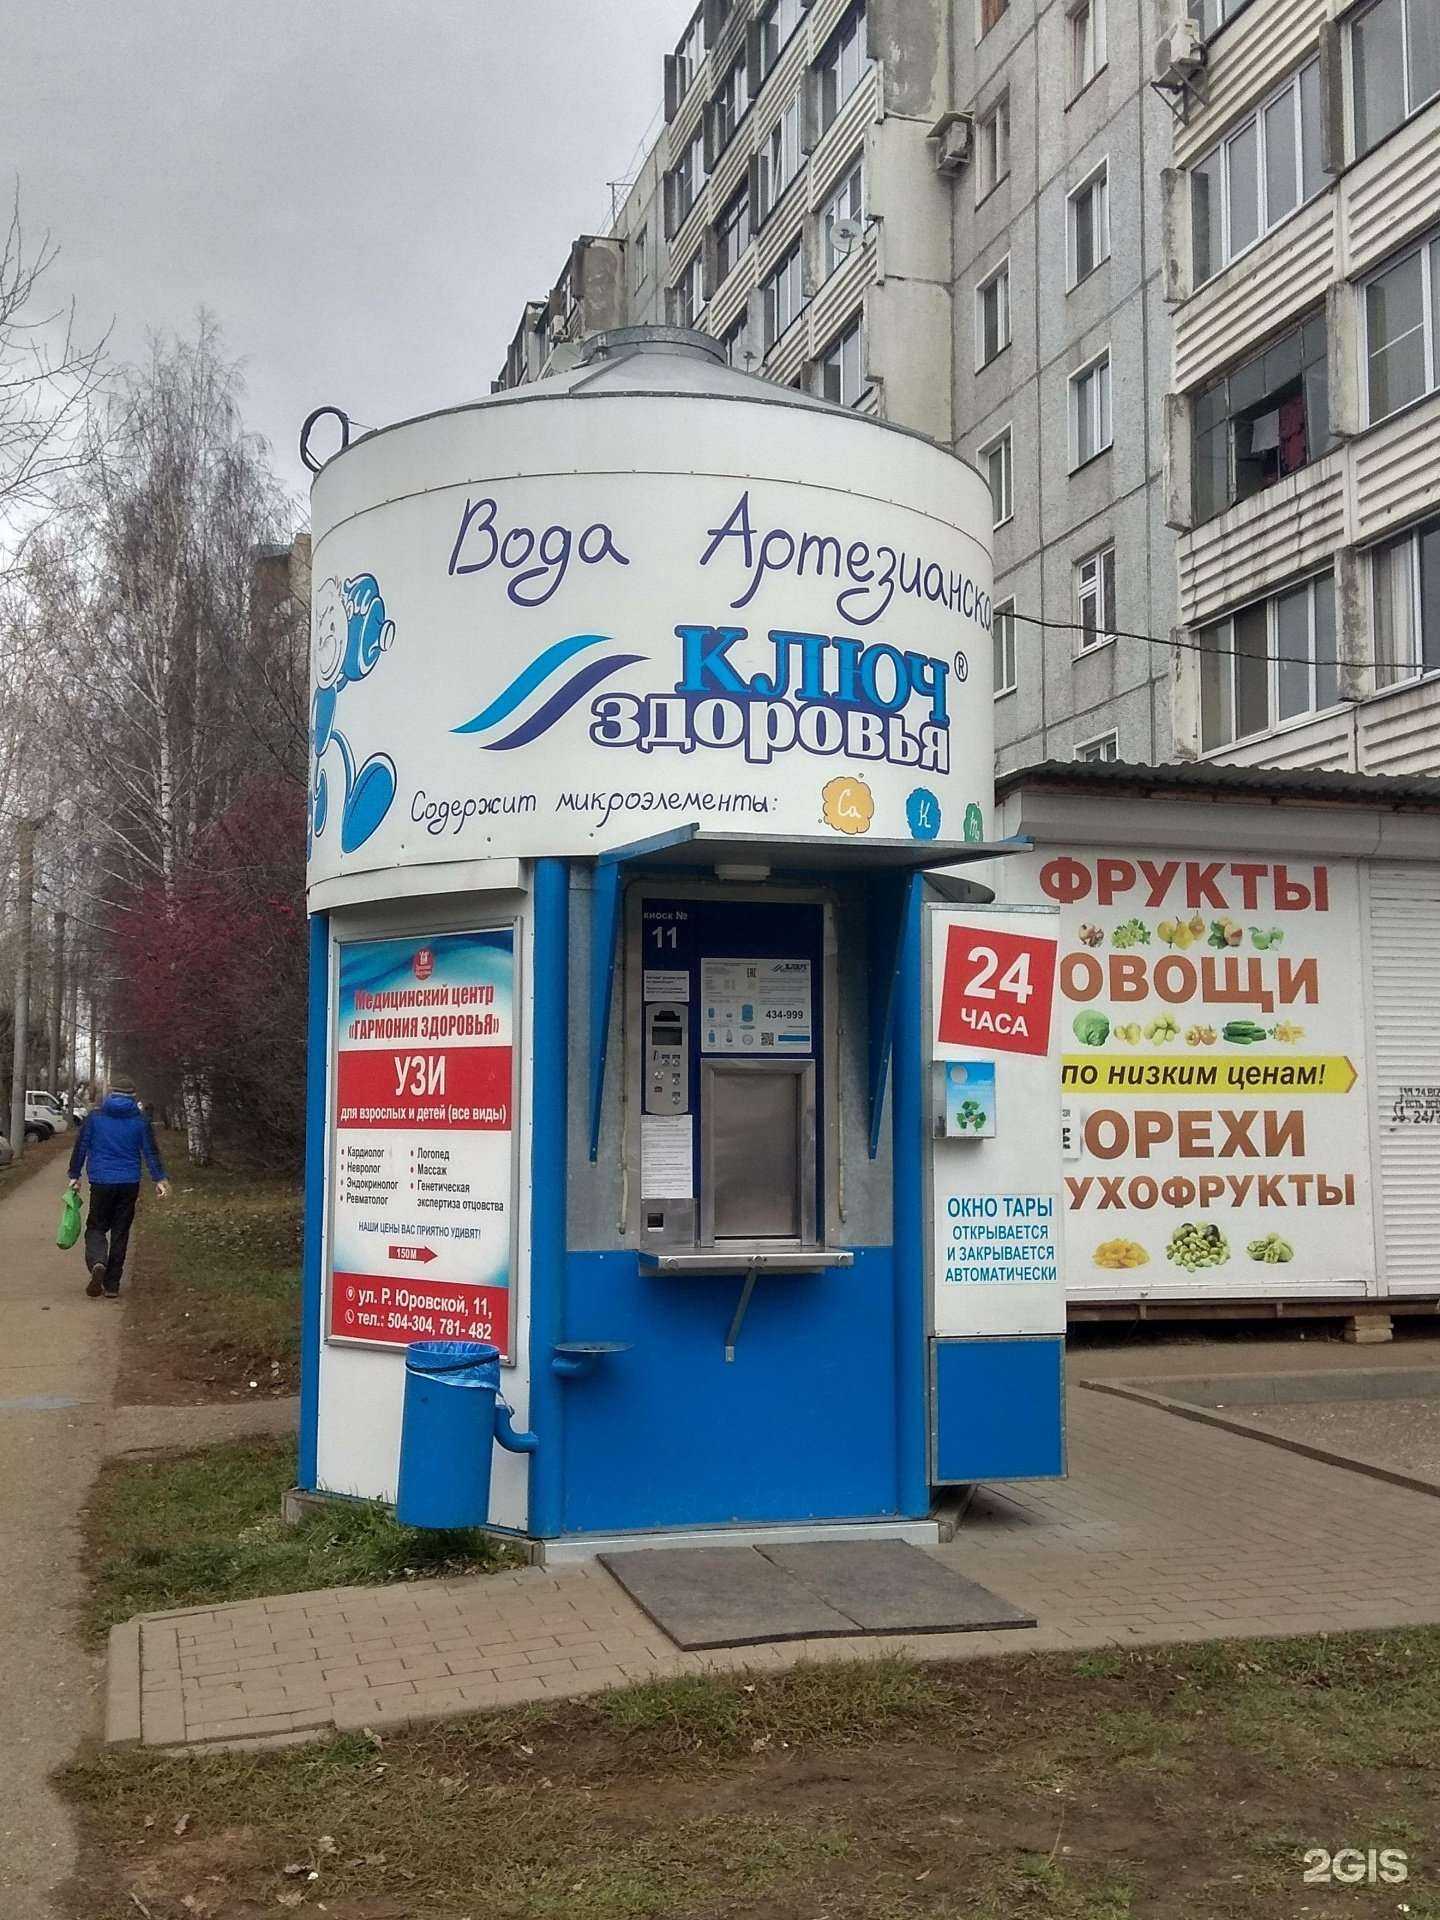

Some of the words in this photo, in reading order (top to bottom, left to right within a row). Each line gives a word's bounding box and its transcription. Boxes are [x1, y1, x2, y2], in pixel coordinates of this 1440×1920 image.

[448, 498, 629, 606] Вода
[410, 789, 537, 835] Содержит
[556, 790, 779, 827] микроэлементы:
[1039, 856, 1330, 912] ФРУКТЫ
[652, 926, 677, 949] 11
[963, 946, 1033, 1005] 24
[1060, 952, 1320, 1013] ОВОЩИ
[355, 984, 449, 1011] Медицинский
[452, 986, 494, 1006] центр
[765, 1010, 804, 1020] 434-999
[961, 1007, 1029, 1037] ЧАСА
[349, 1017, 418, 1040] «ГАРМОНИЯ
[421, 1014, 500, 1040] ЗДОРОВЬЯ»
[394, 1055, 446, 1096] УЗИ
[1061, 1064, 1098, 1085] по
[1108, 1063, 1218, 1086] низким
[1227, 1062, 1326, 1090] ценам!
[341, 1107, 358, 1121] для
[360, 1107, 405, 1122] взрослых
[409, 1109, 414, 1119] и
[417, 1105, 446, 1121] детей
[448, 1105, 470, 1123] (все
[472, 1105, 506, 1124] виды)
[1084, 1108, 1306, 1160] ОРЕХИ
[347, 1147, 385, 1159] Кардиолог
[417, 1147, 450, 1160] Логопед
[347, 1163, 381, 1174] Невролог
[417, 1164, 447, 1175] Массаж
[346, 1178, 399, 1190] Эндокринолог
[417, 1180, 470, 1193] Генетическая
[346, 1194, 389, 1205] Ревматолог
[417, 1199, 461, 1211] экспертиза
[462, 1200, 504, 1212] отцовства
[947, 1197, 998, 1218] ОКНО
[1003, 1197, 1053, 1219] ТАРЫ
[358, 1221, 379, 1232] НАШИ
[379, 1222, 399, 1234] ЦЕНЫ
[401, 1223, 415, 1235] ВАС
[417, 1225, 449, 1237] ПРИЯТНО
[451, 1227, 481, 1239] УДИВЯТ!
[952, 1225, 1048, 1241] ОТКРЫВАЕТСЯ
[947, 1246, 956, 1261] И
[959, 1245, 1055, 1261] ЗАКРЫВАЕТСЯ
[945, 1264, 1057, 1283] АВТОМАТИЧЕСКИ
[358, 1290, 377, 1306] ул.
[381, 1287, 392, 1305] Р.
[395, 1288, 469, 1317] Юровской,
[473, 1297, 493, 1319] 11,
[357, 1312, 384, 1328] тел.:
[387, 1314, 436, 1336] 504-304,
[468, 1322, 492, 1340] 482
